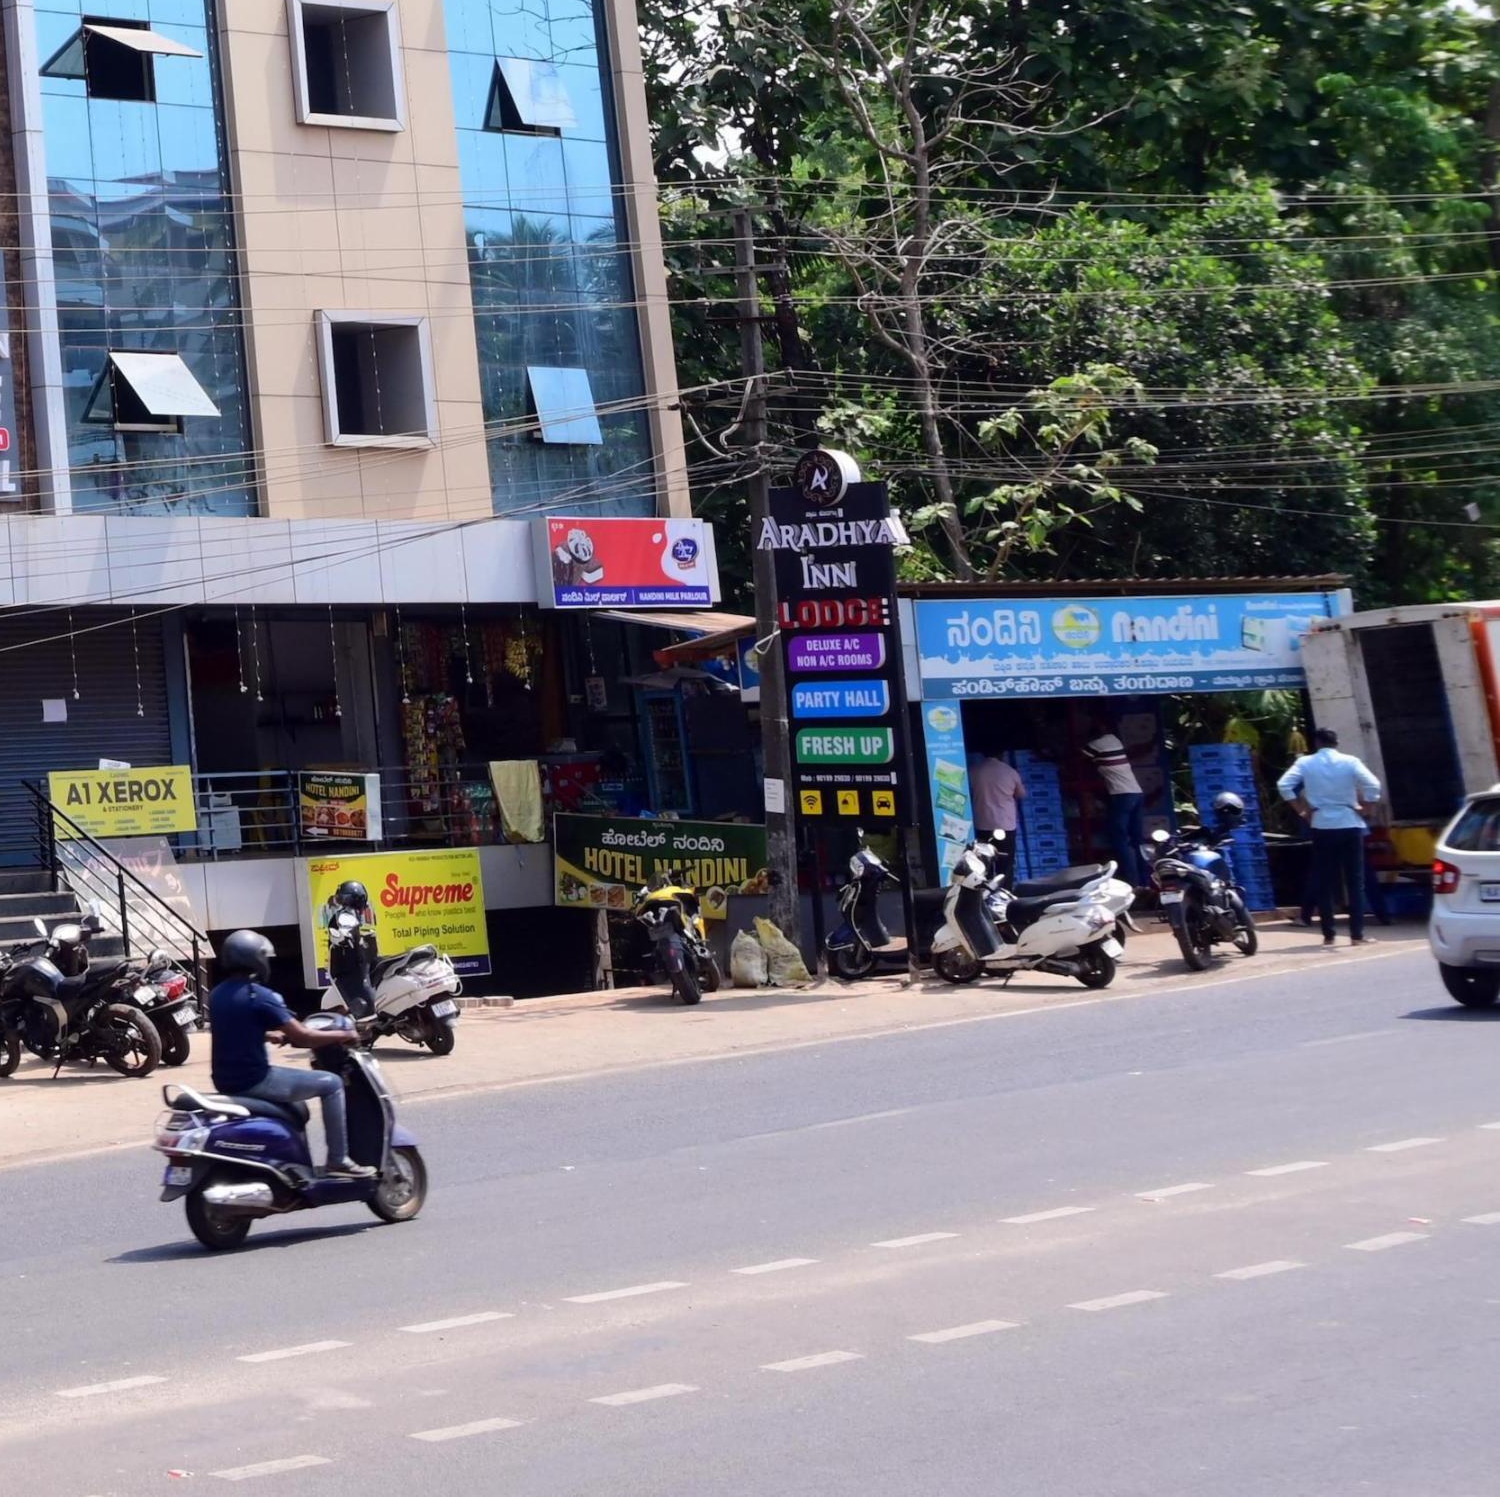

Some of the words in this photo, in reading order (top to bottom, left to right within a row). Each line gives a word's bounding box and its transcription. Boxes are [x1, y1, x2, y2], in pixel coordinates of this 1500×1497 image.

[757, 515, 905, 552] ARADHYA
[801, 556, 857, 588] INN
[639, 591, 665, 600] NANDINI
[665, 591, 680, 600] MILK
[680, 591, 708, 601] PARLOUR
[778, 598, 889, 628] LODGE
[946, 609, 1041, 647] ನಂದಿನಿ
[806, 639, 841, 651] DELUXE
[844, 638, 860, 650] A/C
[797, 655, 817, 667] NON
[819, 655, 836, 666] A/C
[838, 654, 872, 665] ROOMS
[796, 691, 840, 708] PARTY
[845, 690, 881, 707] HALL
[802, 736, 855, 755] FRESH
[860, 736, 883, 754] UP
[66, 782, 91, 806] A1
[96, 778, 177, 804] XEROX
[305, 783, 326, 796] HOTEL
[328, 785, 360, 797] NANDINI
[601, 828, 666, 848] ಹೋಟೆಲ್
[673, 834, 725, 852] ನಂದಿನಿ
[584, 847, 648, 884] HOTEL
[380, 872, 475, 914] Supreme
[385, 909, 406, 919] People
[427, 908, 442, 916] know
[443, 906, 464, 917] plastics
[464, 906, 476, 914] best
[392, 927, 412, 939] Total
[413, 925, 440, 939] Piping
[441, 924, 475, 935] Solution
